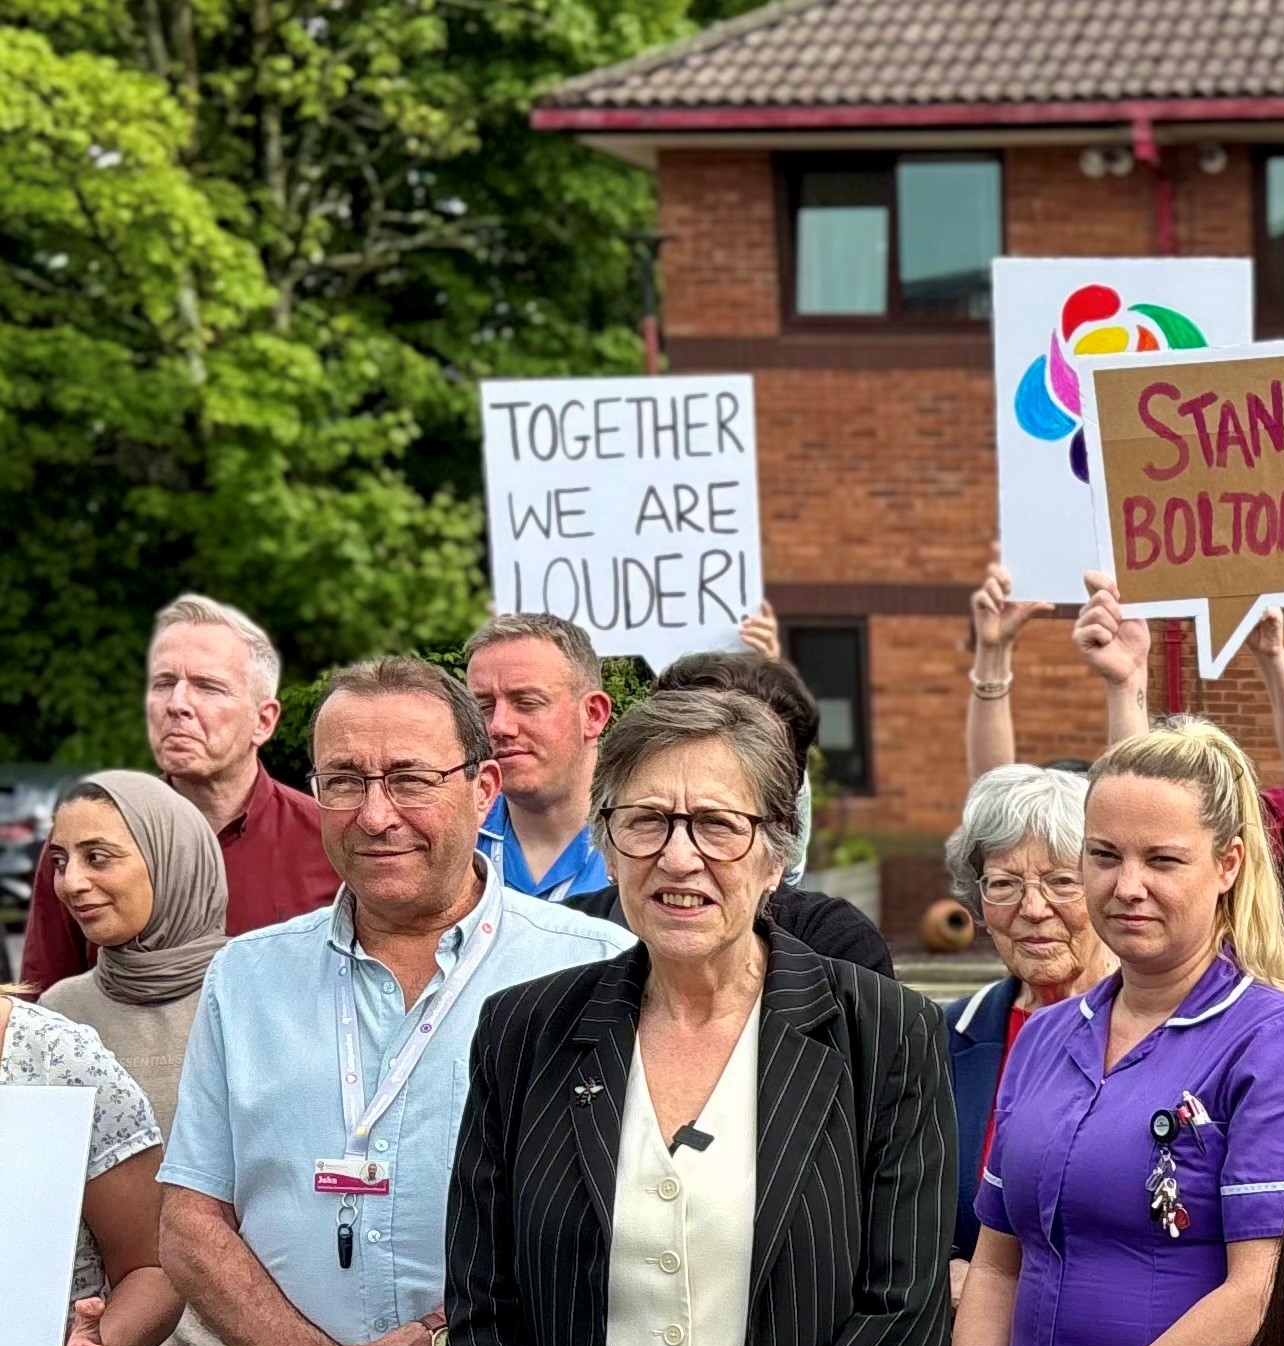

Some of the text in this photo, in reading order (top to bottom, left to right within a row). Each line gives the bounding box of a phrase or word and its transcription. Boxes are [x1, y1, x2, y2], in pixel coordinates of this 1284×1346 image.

[489, 391, 745, 461] TOGETHER
[508, 480, 740, 540] WE ARE
